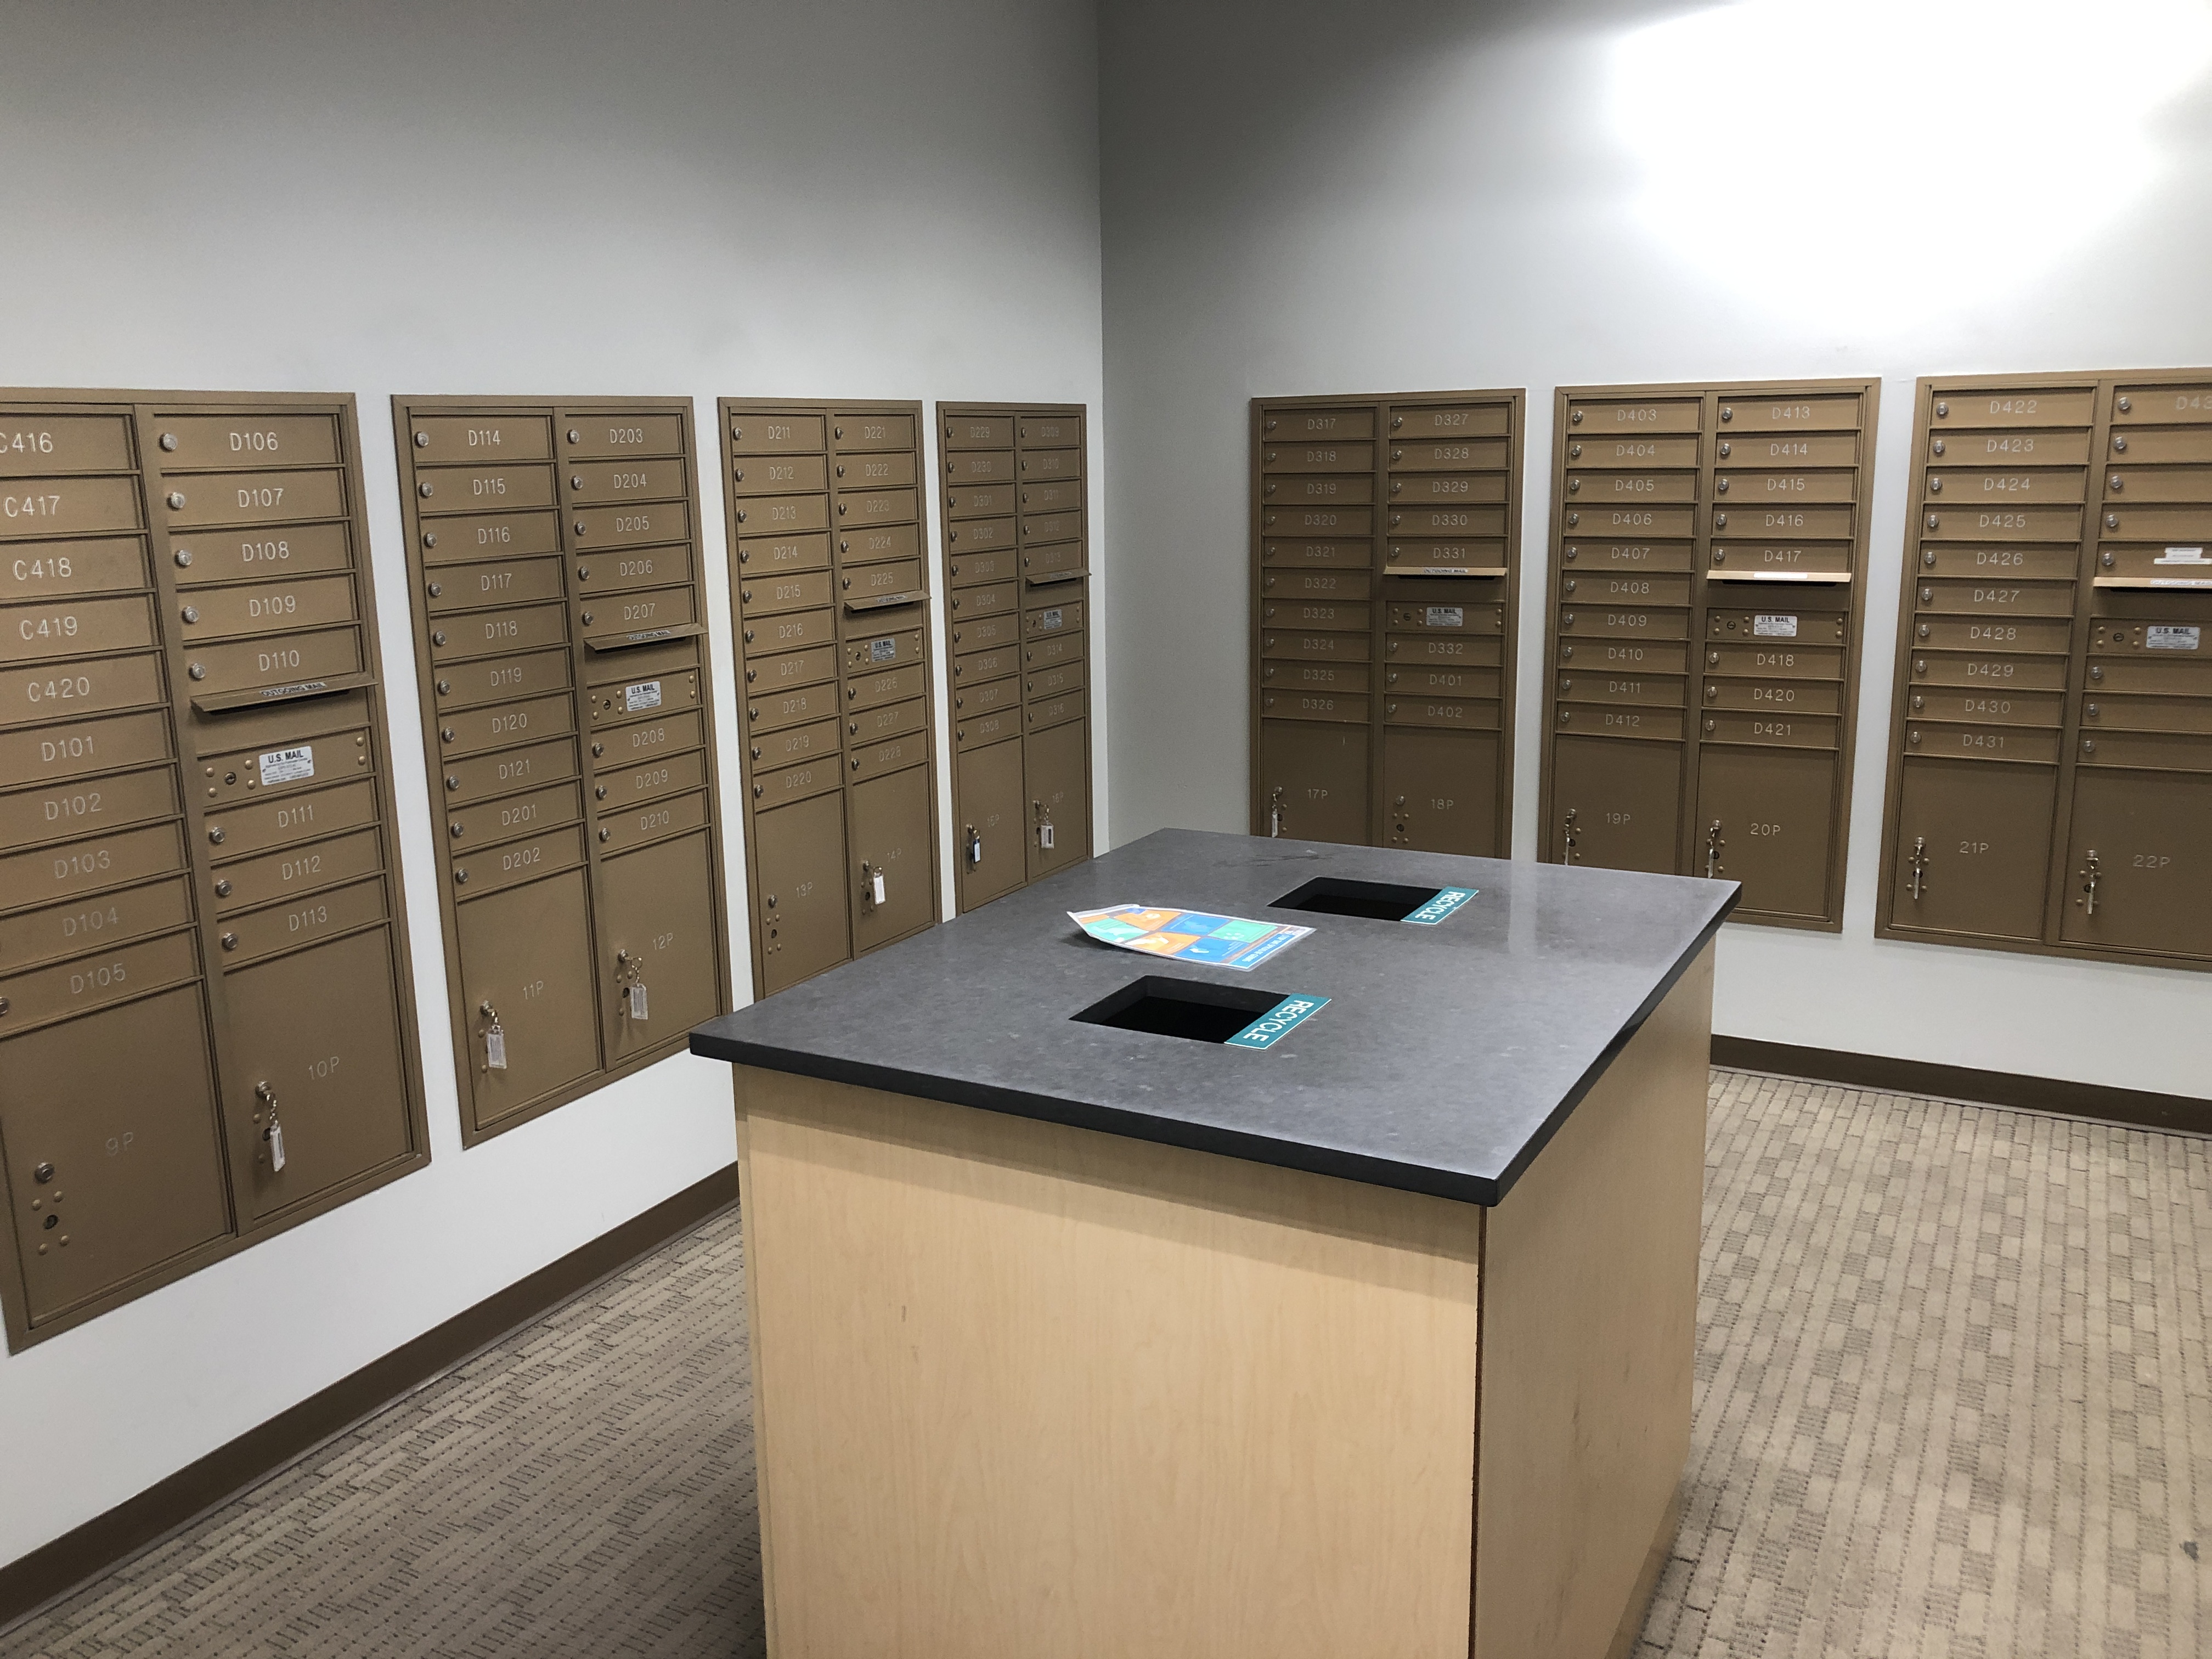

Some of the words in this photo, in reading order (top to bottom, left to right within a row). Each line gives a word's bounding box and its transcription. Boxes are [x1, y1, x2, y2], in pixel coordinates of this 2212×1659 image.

[1773, 407, 1810, 419] D413
[1990, 400, 2036, 413] D422
[1435, 414, 1468, 426] D327
[1618, 409, 1656, 421] D403
[1308, 418, 1336, 430] D317
[469, 430, 500, 445] D114
[610, 428, 642, 443] D203
[769, 426, 790, 439] D211
[865, 426, 885, 438] D221
[230, 432, 278, 450] D106
[1987, 439, 2033, 452] D423
[1307, 451, 1336, 461] D318
[1435, 448, 1469, 459] D328
[1617, 445, 1655, 456] D404
[1771, 444, 1807, 455] D414
[770, 466, 793, 479] D212
[866, 464, 888, 476] D222
[473, 478, 505, 495] D115
[614, 474, 646, 488] D204
[1433, 481, 1468, 492] D329
[1616, 479, 1654, 491] D405
[1768, 478, 1804, 490] D415
[1984, 478, 2030, 490] D424
[1307, 483, 1336, 494] D319
[238, 488, 283, 507] D107
[5, 495, 60, 517] C417
[867, 500, 889, 512] D223
[772, 506, 795, 520] D213
[1613, 514, 1652, 525] D406
[617, 516, 649, 532] D205
[1305, 515, 1336, 525] D320
[1432, 515, 1468, 526] D330
[1766, 515, 1803, 526] D416
[1980, 515, 2025, 527] D425
[478, 527, 510, 544] D116
[974, 527, 992, 539] D302
[869, 537, 891, 549] D224
[242, 541, 289, 561] D108
[774, 546, 797, 560] D214
[1306, 546, 1335, 557] D321
[1434, 548, 1465, 558] D331
[1612, 548, 1650, 559] D407
[1765, 550, 1801, 562] D417
[1977, 552, 2023, 565] D426
[13, 557, 71, 580] C418
[620, 560, 652, 576] D206
[481, 573, 512, 590] D117
[871, 572, 893, 586] D225
[1305, 578, 1336, 589] D322
[777, 584, 800, 599] D215
[1611, 582, 1649, 594] D408
[977, 594, 995, 606] D304
[1974, 590, 2019, 602] D427
[250, 595, 295, 616] D109
[624, 603, 655, 620] D207
[1304, 607, 1334, 619] D323
[1608, 614, 1646, 627] D409
[20, 616, 77, 640] C419
[486, 620, 517, 639] D118
[780, 623, 803, 638] D216
[1971, 627, 2016, 640] D428
[1047, 644, 1062, 656] D314
[1304, 639, 1334, 650] D324
[1429, 642, 1463, 654] D332
[1609, 647, 1643, 660] D410
[1757, 653, 1793, 667] D418
[259, 650, 299, 672] D110
[781, 660, 804, 675] D217
[979, 657, 997, 670] D306
[1304, 669, 1334, 680] D325
[1968, 663, 2013, 677] D429
[490, 668, 521, 686] D119
[1430, 674, 1461, 686] D401
[28, 677, 89, 702] C420
[642, 684, 655, 692] MAIL
[876, 677, 897, 692] D226
[1610, 681, 1640, 693] D411
[1754, 689, 1794, 701] D420
[783, 697, 806, 713] D218
[1303, 698, 1333, 710] D326
[1966, 699, 2010, 713] D430
[1428, 706, 1463, 718] D402
[493, 713, 527, 733] D120
[877, 712, 899, 727] D227
[1606, 714, 1639, 726] D412
[1754, 723, 1790, 735] D421
[633, 728, 664, 747] D208
[787, 735, 809, 752] D219
[1963, 734, 2004, 748] D431
[42, 736, 93, 761] D101
[268, 754, 284, 763] U.S.
[285, 750, 303, 760] MAIL
[499, 759, 529, 779] D121
[636, 769, 668, 789] D209
[786, 771, 811, 788] D220
[1308, 789, 1328, 799] 17P
[44, 793, 101, 820] D102
[1431, 799, 1453, 809] 18P
[278, 805, 313, 827] D111
[502, 804, 536, 826] D201
[641, 810, 669, 830] D210
[1607, 813, 1630, 824] 19P
[1751, 823, 1780, 836] 20P
[1960, 841, 1988, 853] 21P
[55, 850, 110, 878] D103
[503, 848, 540, 870] D202
[2133, 855, 2170, 868] 22P
[282, 855, 320, 880] D112
[797, 882, 812, 898] 13P
[1415, 891, 1466, 920] RECYCLE
[63, 907, 120, 938] D104
[289, 906, 326, 931] D113
[653, 933, 673, 950] 12P
[71, 963, 125, 996] D105
[523, 981, 543, 1000] 11P
[1243, 1000, 1314, 1041] RECYCLE
[309, 1056, 339, 1080] 10P
[106, 1132, 133, 1155] 9P
